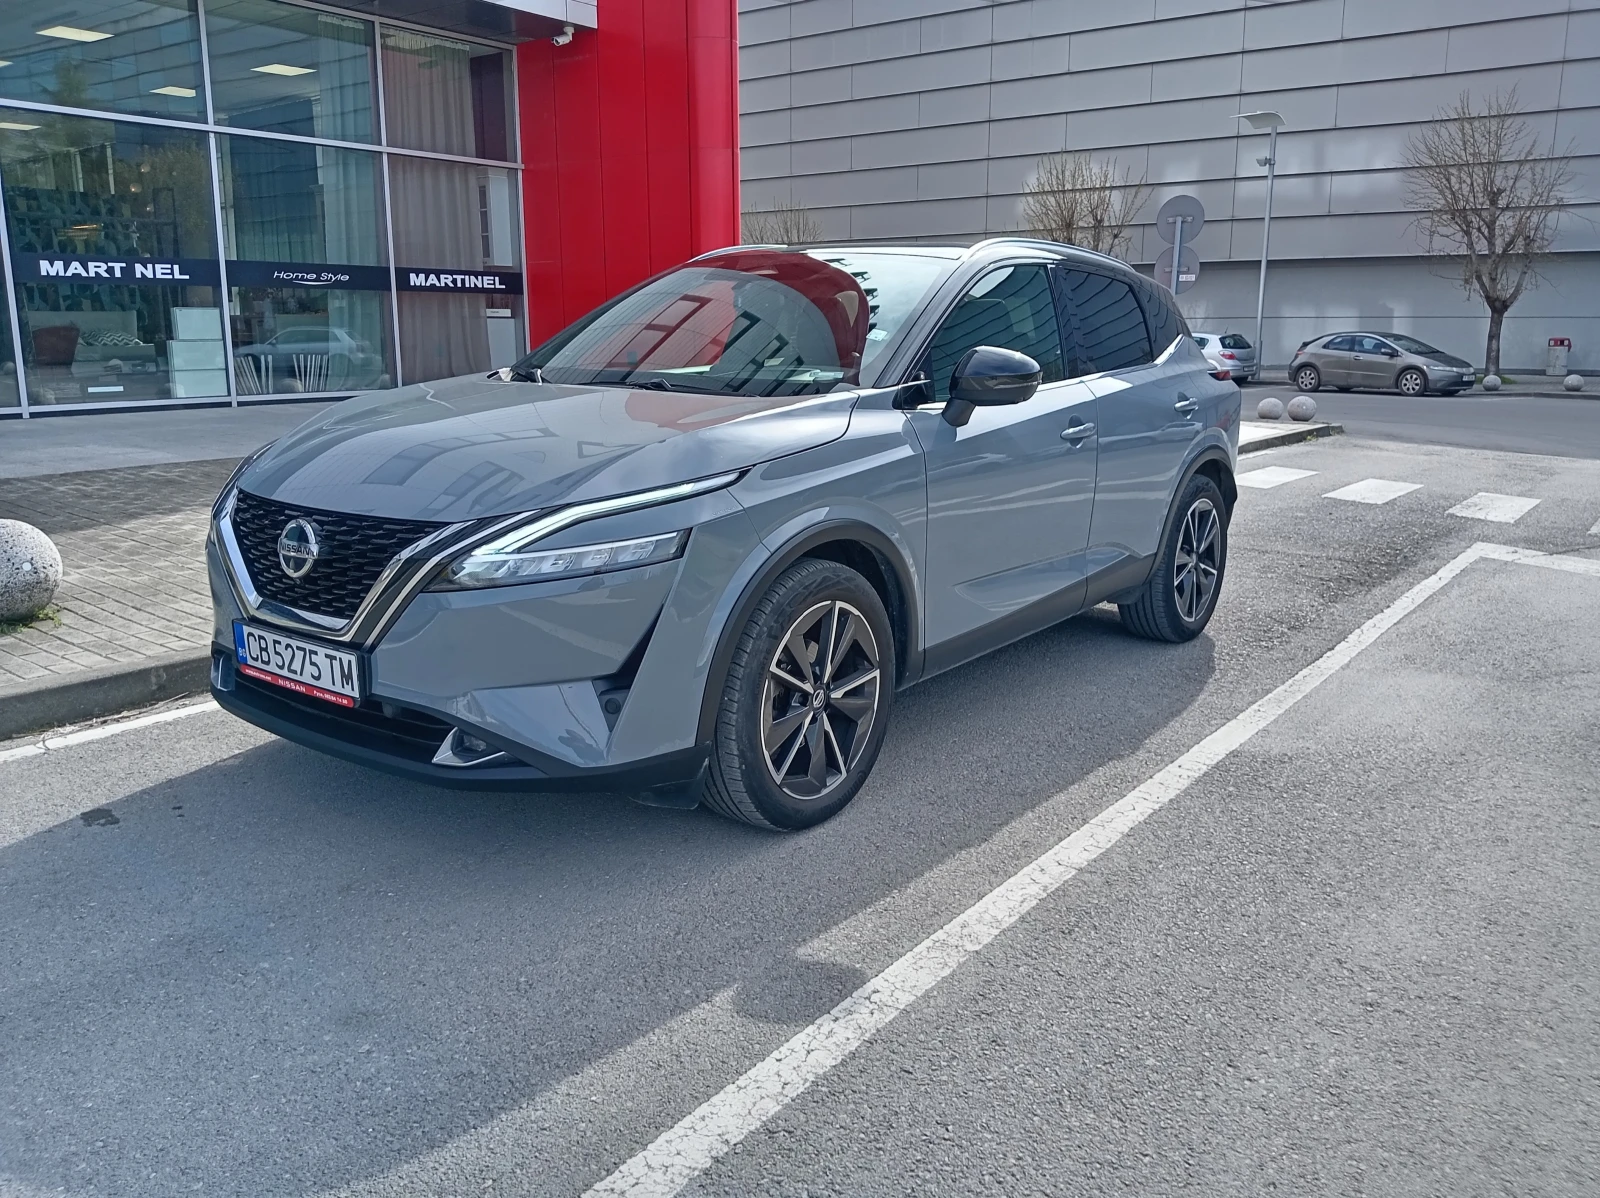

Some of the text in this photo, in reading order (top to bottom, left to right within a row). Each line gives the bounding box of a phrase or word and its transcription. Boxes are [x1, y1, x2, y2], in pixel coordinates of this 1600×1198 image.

[39, 259, 190, 280] MART NEL
[273, 271, 350, 283] Home Style
[409, 272, 506, 289] MARTINEL
[272, 639, 322, 681] 5275
[324, 652, 355, 692] TM
[278, 678, 306, 693] NISSAN
